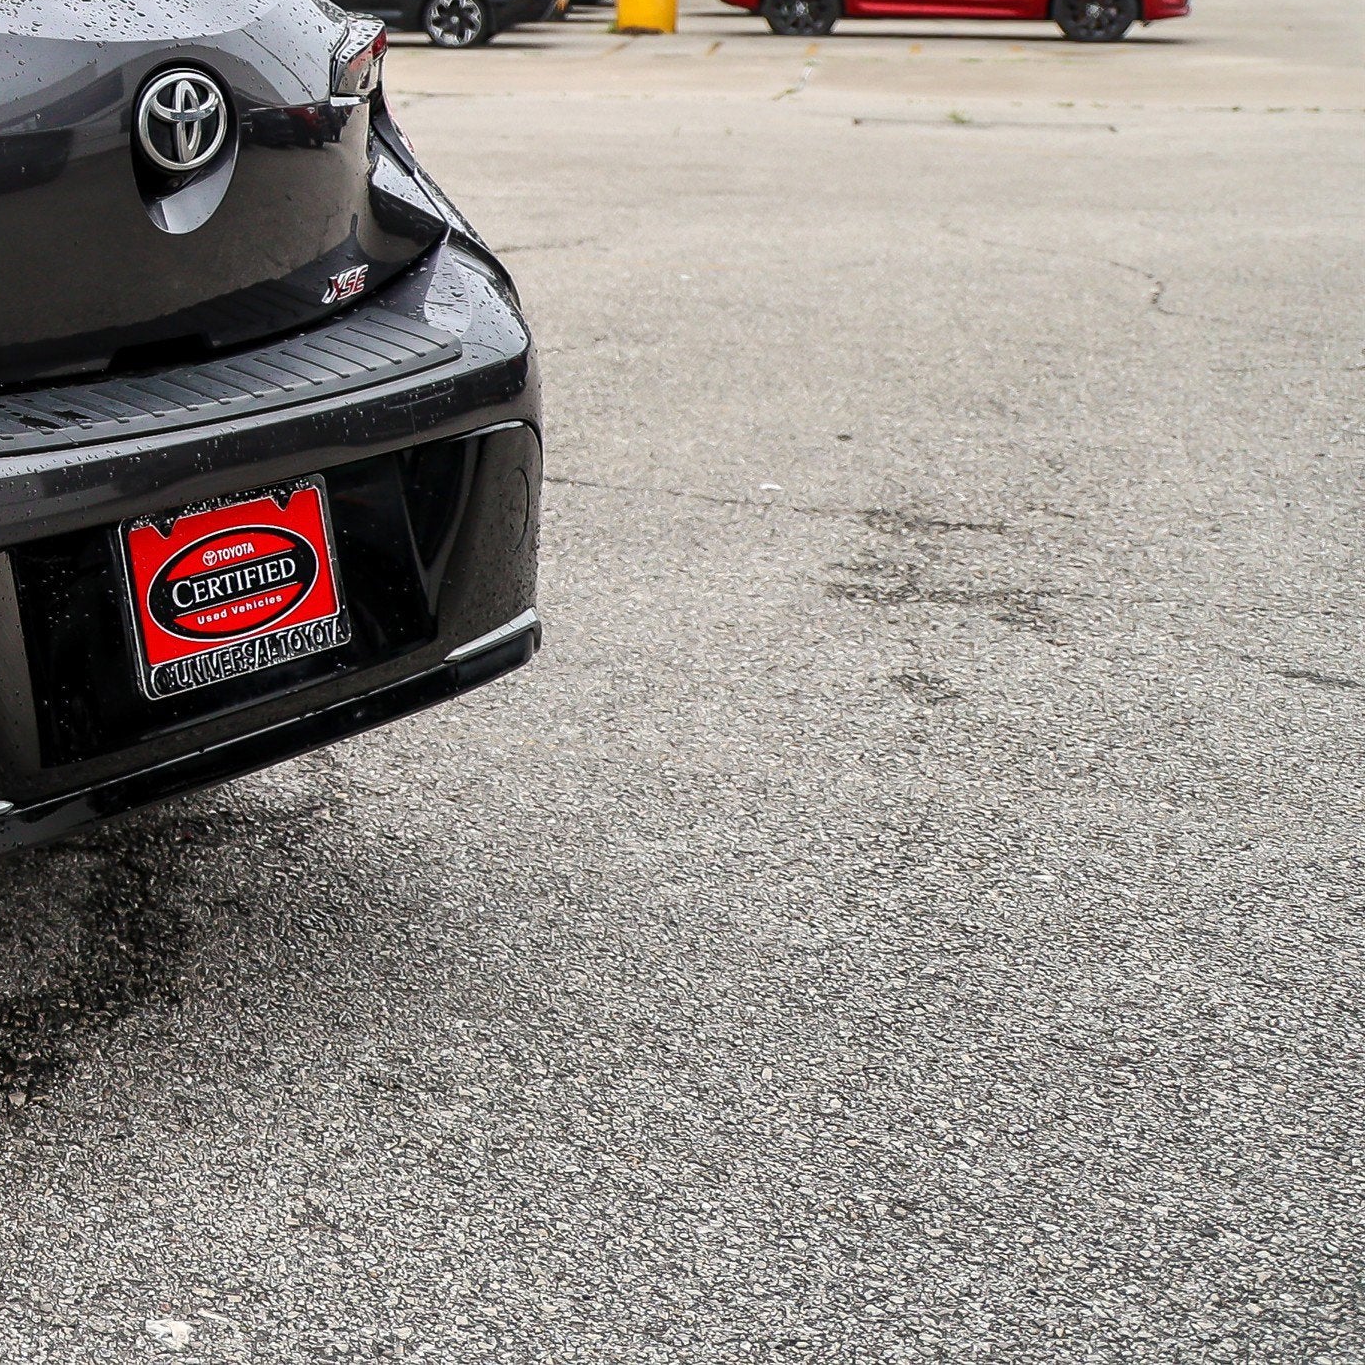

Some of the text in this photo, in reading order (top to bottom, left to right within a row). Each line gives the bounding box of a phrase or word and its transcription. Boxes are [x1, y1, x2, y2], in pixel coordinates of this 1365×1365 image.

[321, 263, 369, 304] XSE
[217, 541, 255, 562] TOYOTA
[196, 594, 283, 625] Used Vehicles
[174, 617, 345, 688] UNIVERSAL TOYOTA
